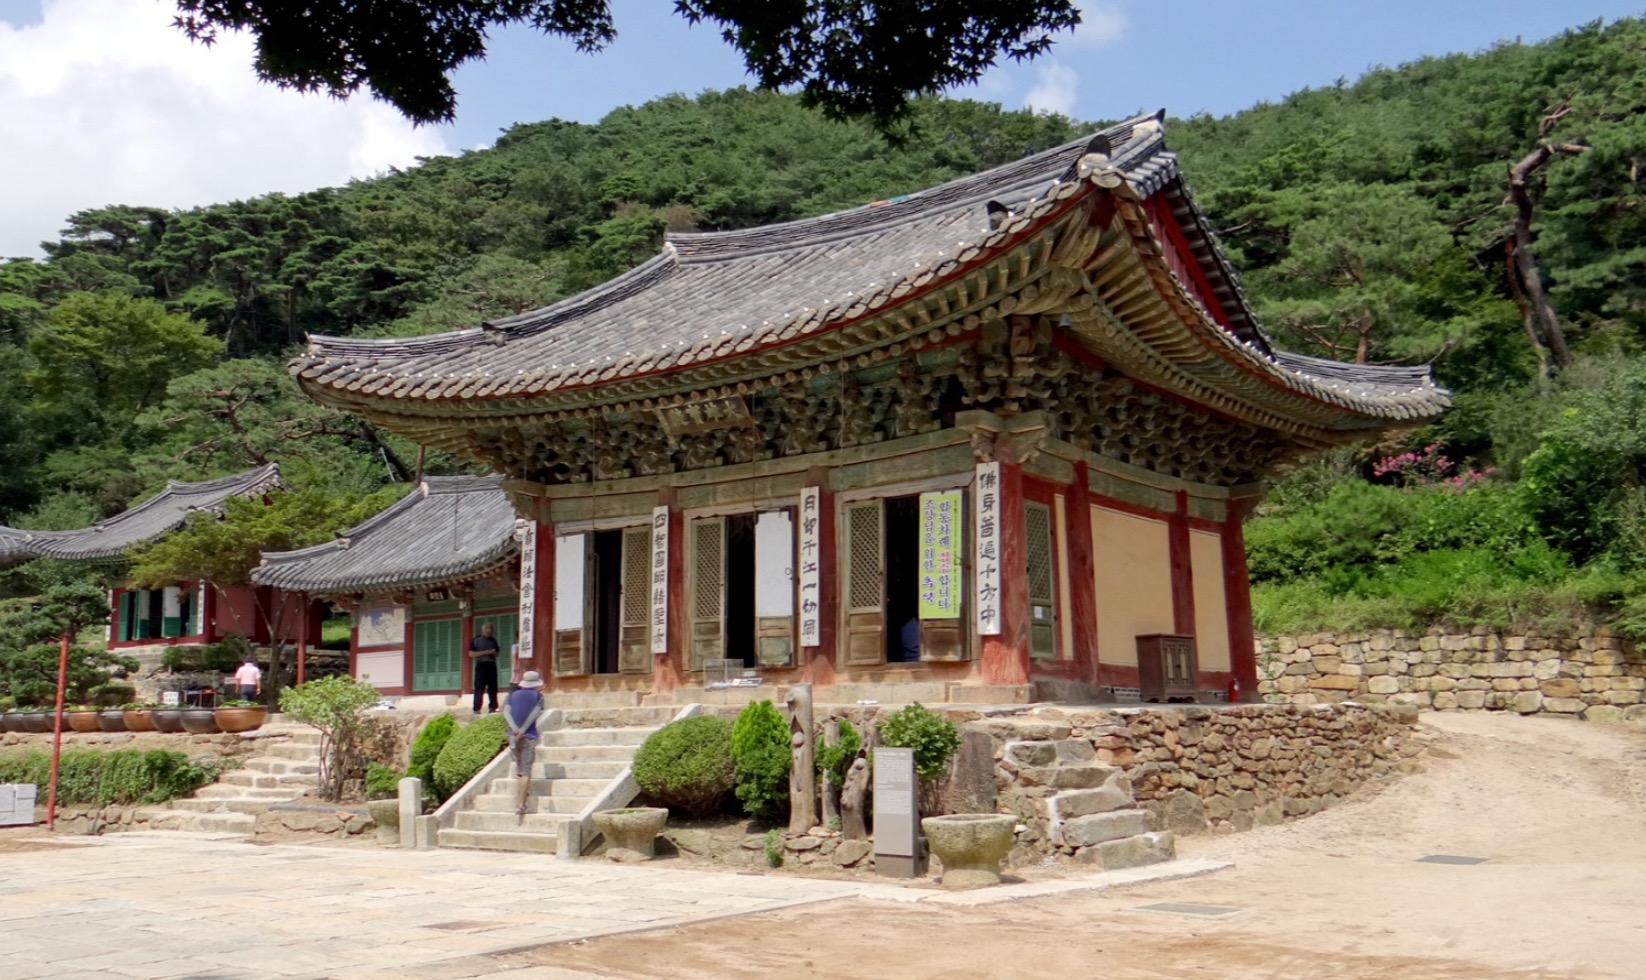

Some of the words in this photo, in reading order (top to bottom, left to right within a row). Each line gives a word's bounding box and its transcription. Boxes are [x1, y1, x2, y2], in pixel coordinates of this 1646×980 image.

[938, 501, 952, 549] 합동차례
[923, 548, 936, 573] 위한
[922, 576, 936, 604] 추석
[938, 551, 952, 611] 접수합니다
